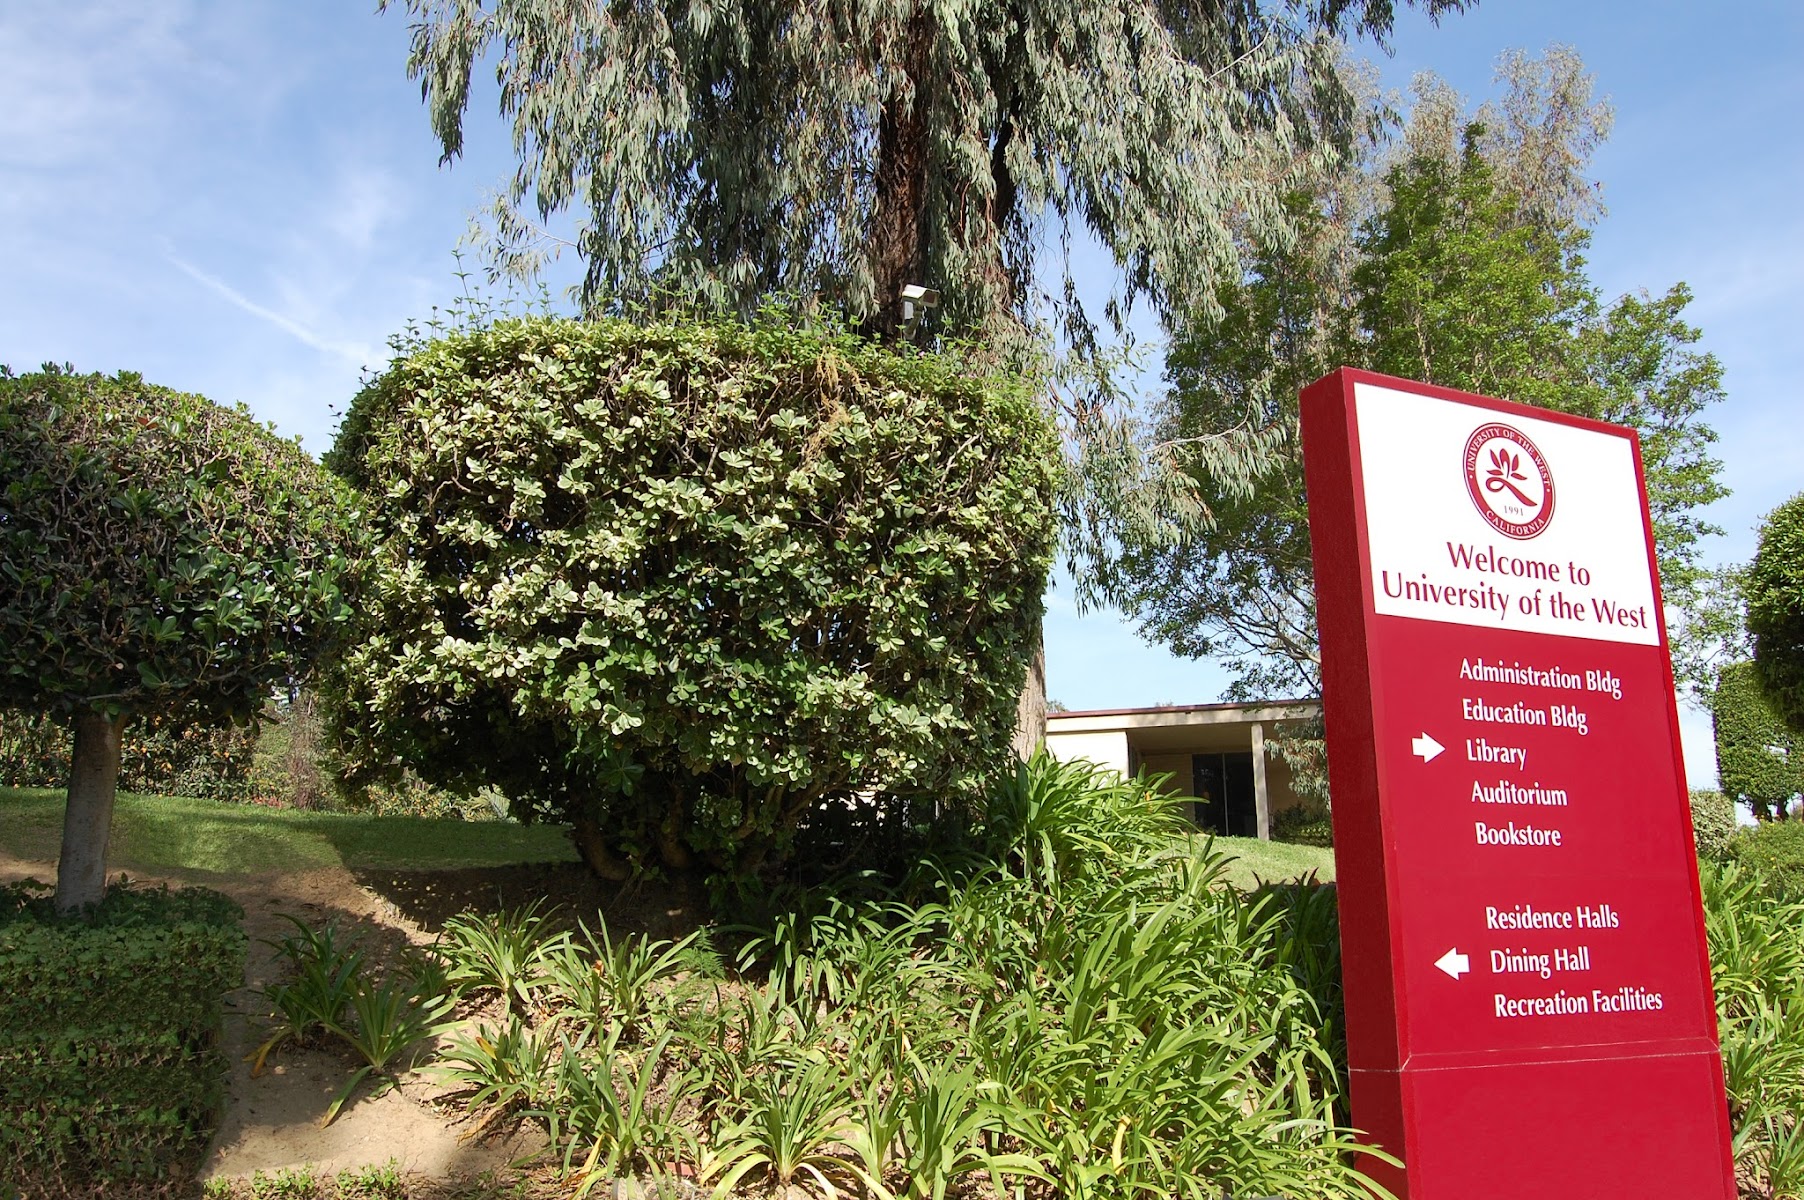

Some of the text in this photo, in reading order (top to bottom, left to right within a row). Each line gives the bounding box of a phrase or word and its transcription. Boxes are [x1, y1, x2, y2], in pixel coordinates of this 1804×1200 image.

[1468, 428, 1551, 487] UNIVERSITY OF THE WEST
[1486, 510, 1545, 535] CALIFORNIA
[1504, 505, 1524, 516] 1991
[1447, 542, 1590, 585] Welcome to
[1382, 570, 1647, 628] University of the West
[1460, 658, 1622, 700] Administration Bldg
[1463, 698, 1588, 735] Education Bldg
[1467, 738, 1526, 770] Library
[1472, 780, 1567, 805] Auditorium
[1475, 822, 1561, 846] Bookstore
[1486, 905, 1618, 929] Residence Halls
[1491, 946, 1589, 979] Dining Hall
[1495, 987, 1662, 1017] Recreation Facilities
